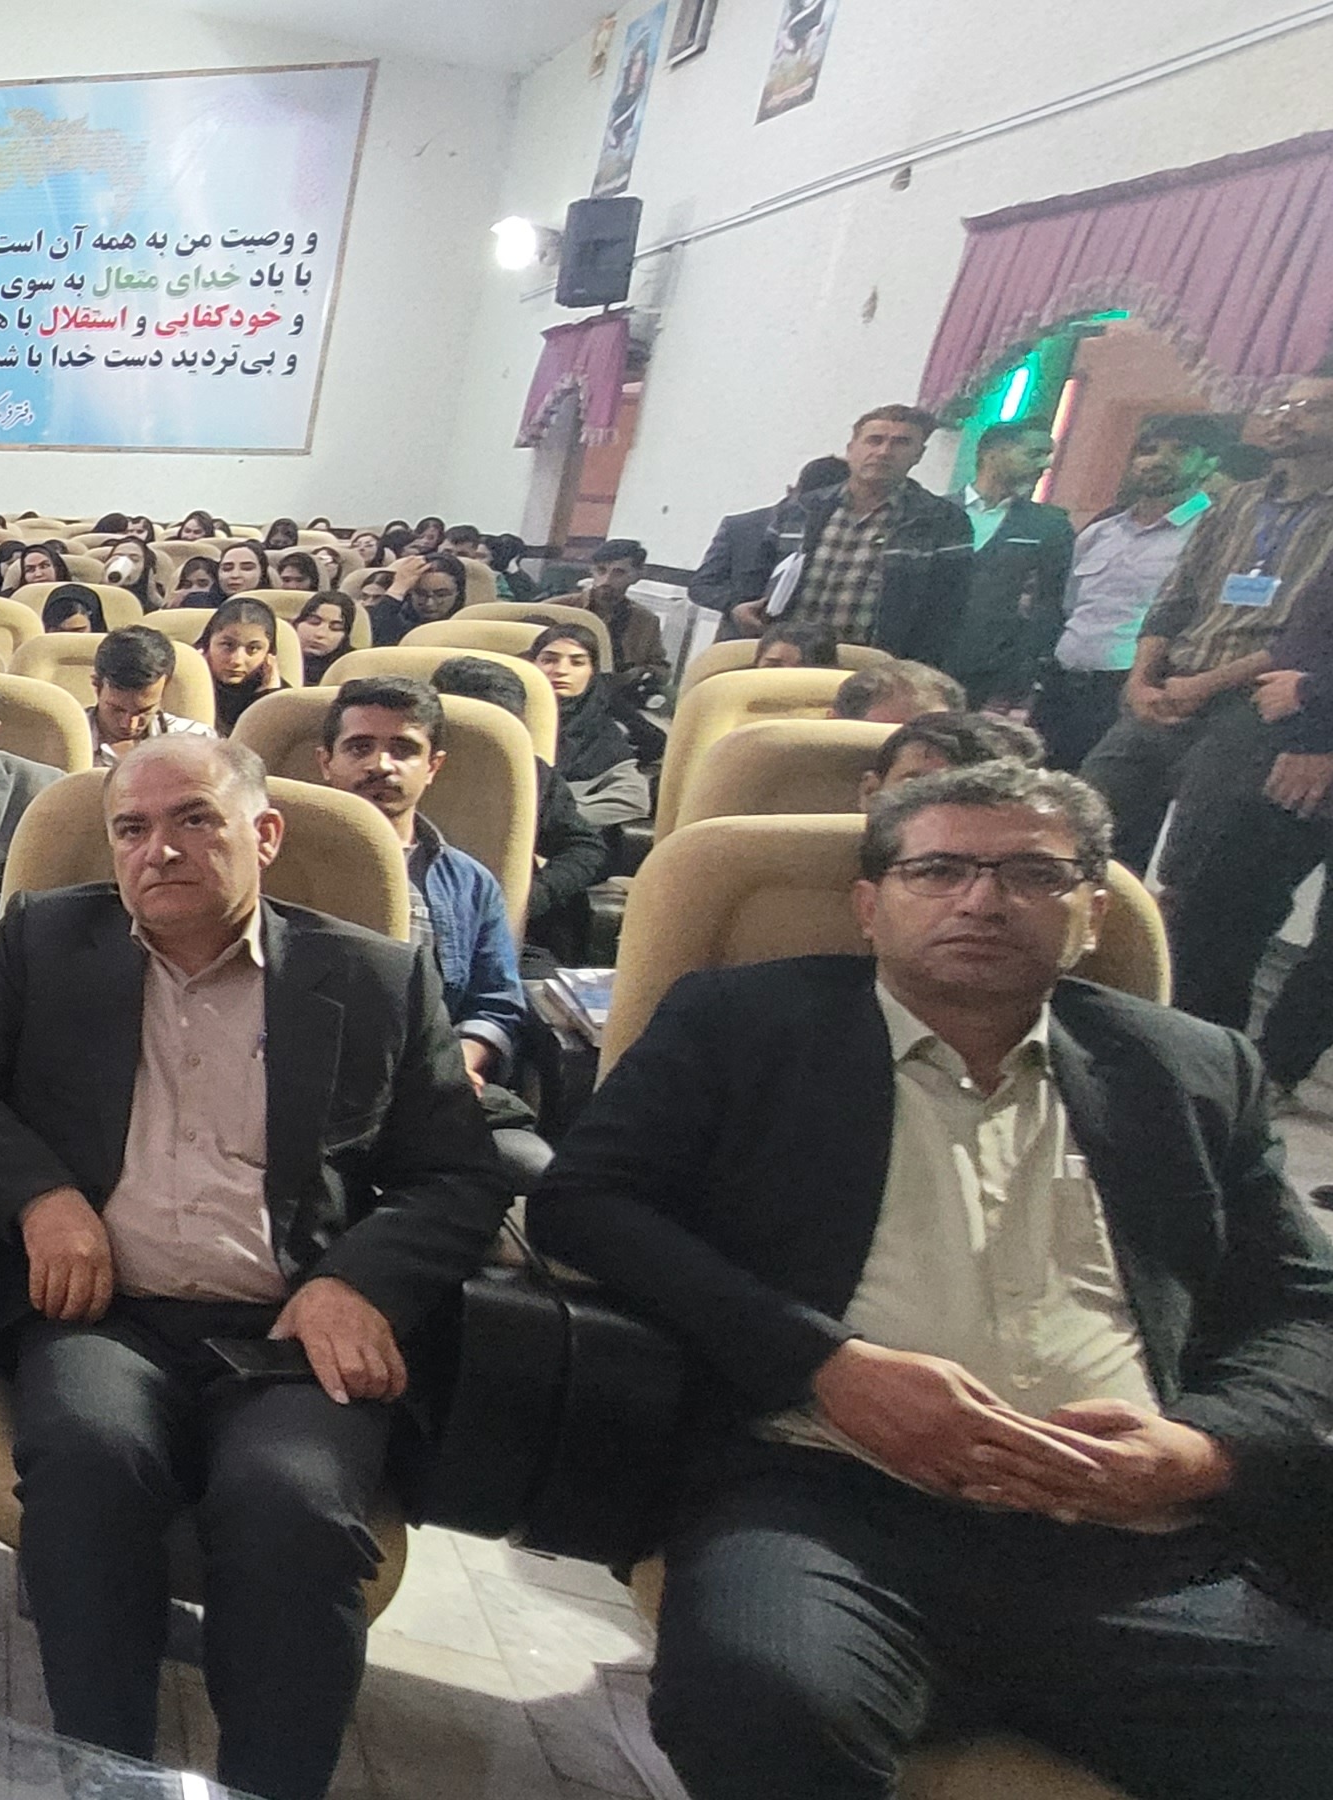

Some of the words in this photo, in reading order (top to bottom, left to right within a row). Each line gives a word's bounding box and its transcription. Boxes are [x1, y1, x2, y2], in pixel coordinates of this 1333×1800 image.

[47, 224, 88, 261] آن
[90, 229, 137, 252] همه
[144, 228, 168, 259] به
[175, 231, 212, 258] من
[219, 226, 295, 255] وصیت
[305, 229, 318, 256] و
[0, 277, 56, 300] سوی
[62, 270, 86, 300] به
[91, 264, 159, 298] متعال
[165, 261, 241, 298] خدای
[248, 262, 285, 294] یاد
[293, 261, 313, 295] با
[16, 306, 33, 337] با
[38, 303, 129, 337] استقلال
[131, 312, 147, 338] و
[287, 312, 305, 336] و
[25, 343, 43, 374] با
[49, 343, 96, 370] خدا
[103, 347, 164, 370] دست
[281, 352, 298, 377] و
